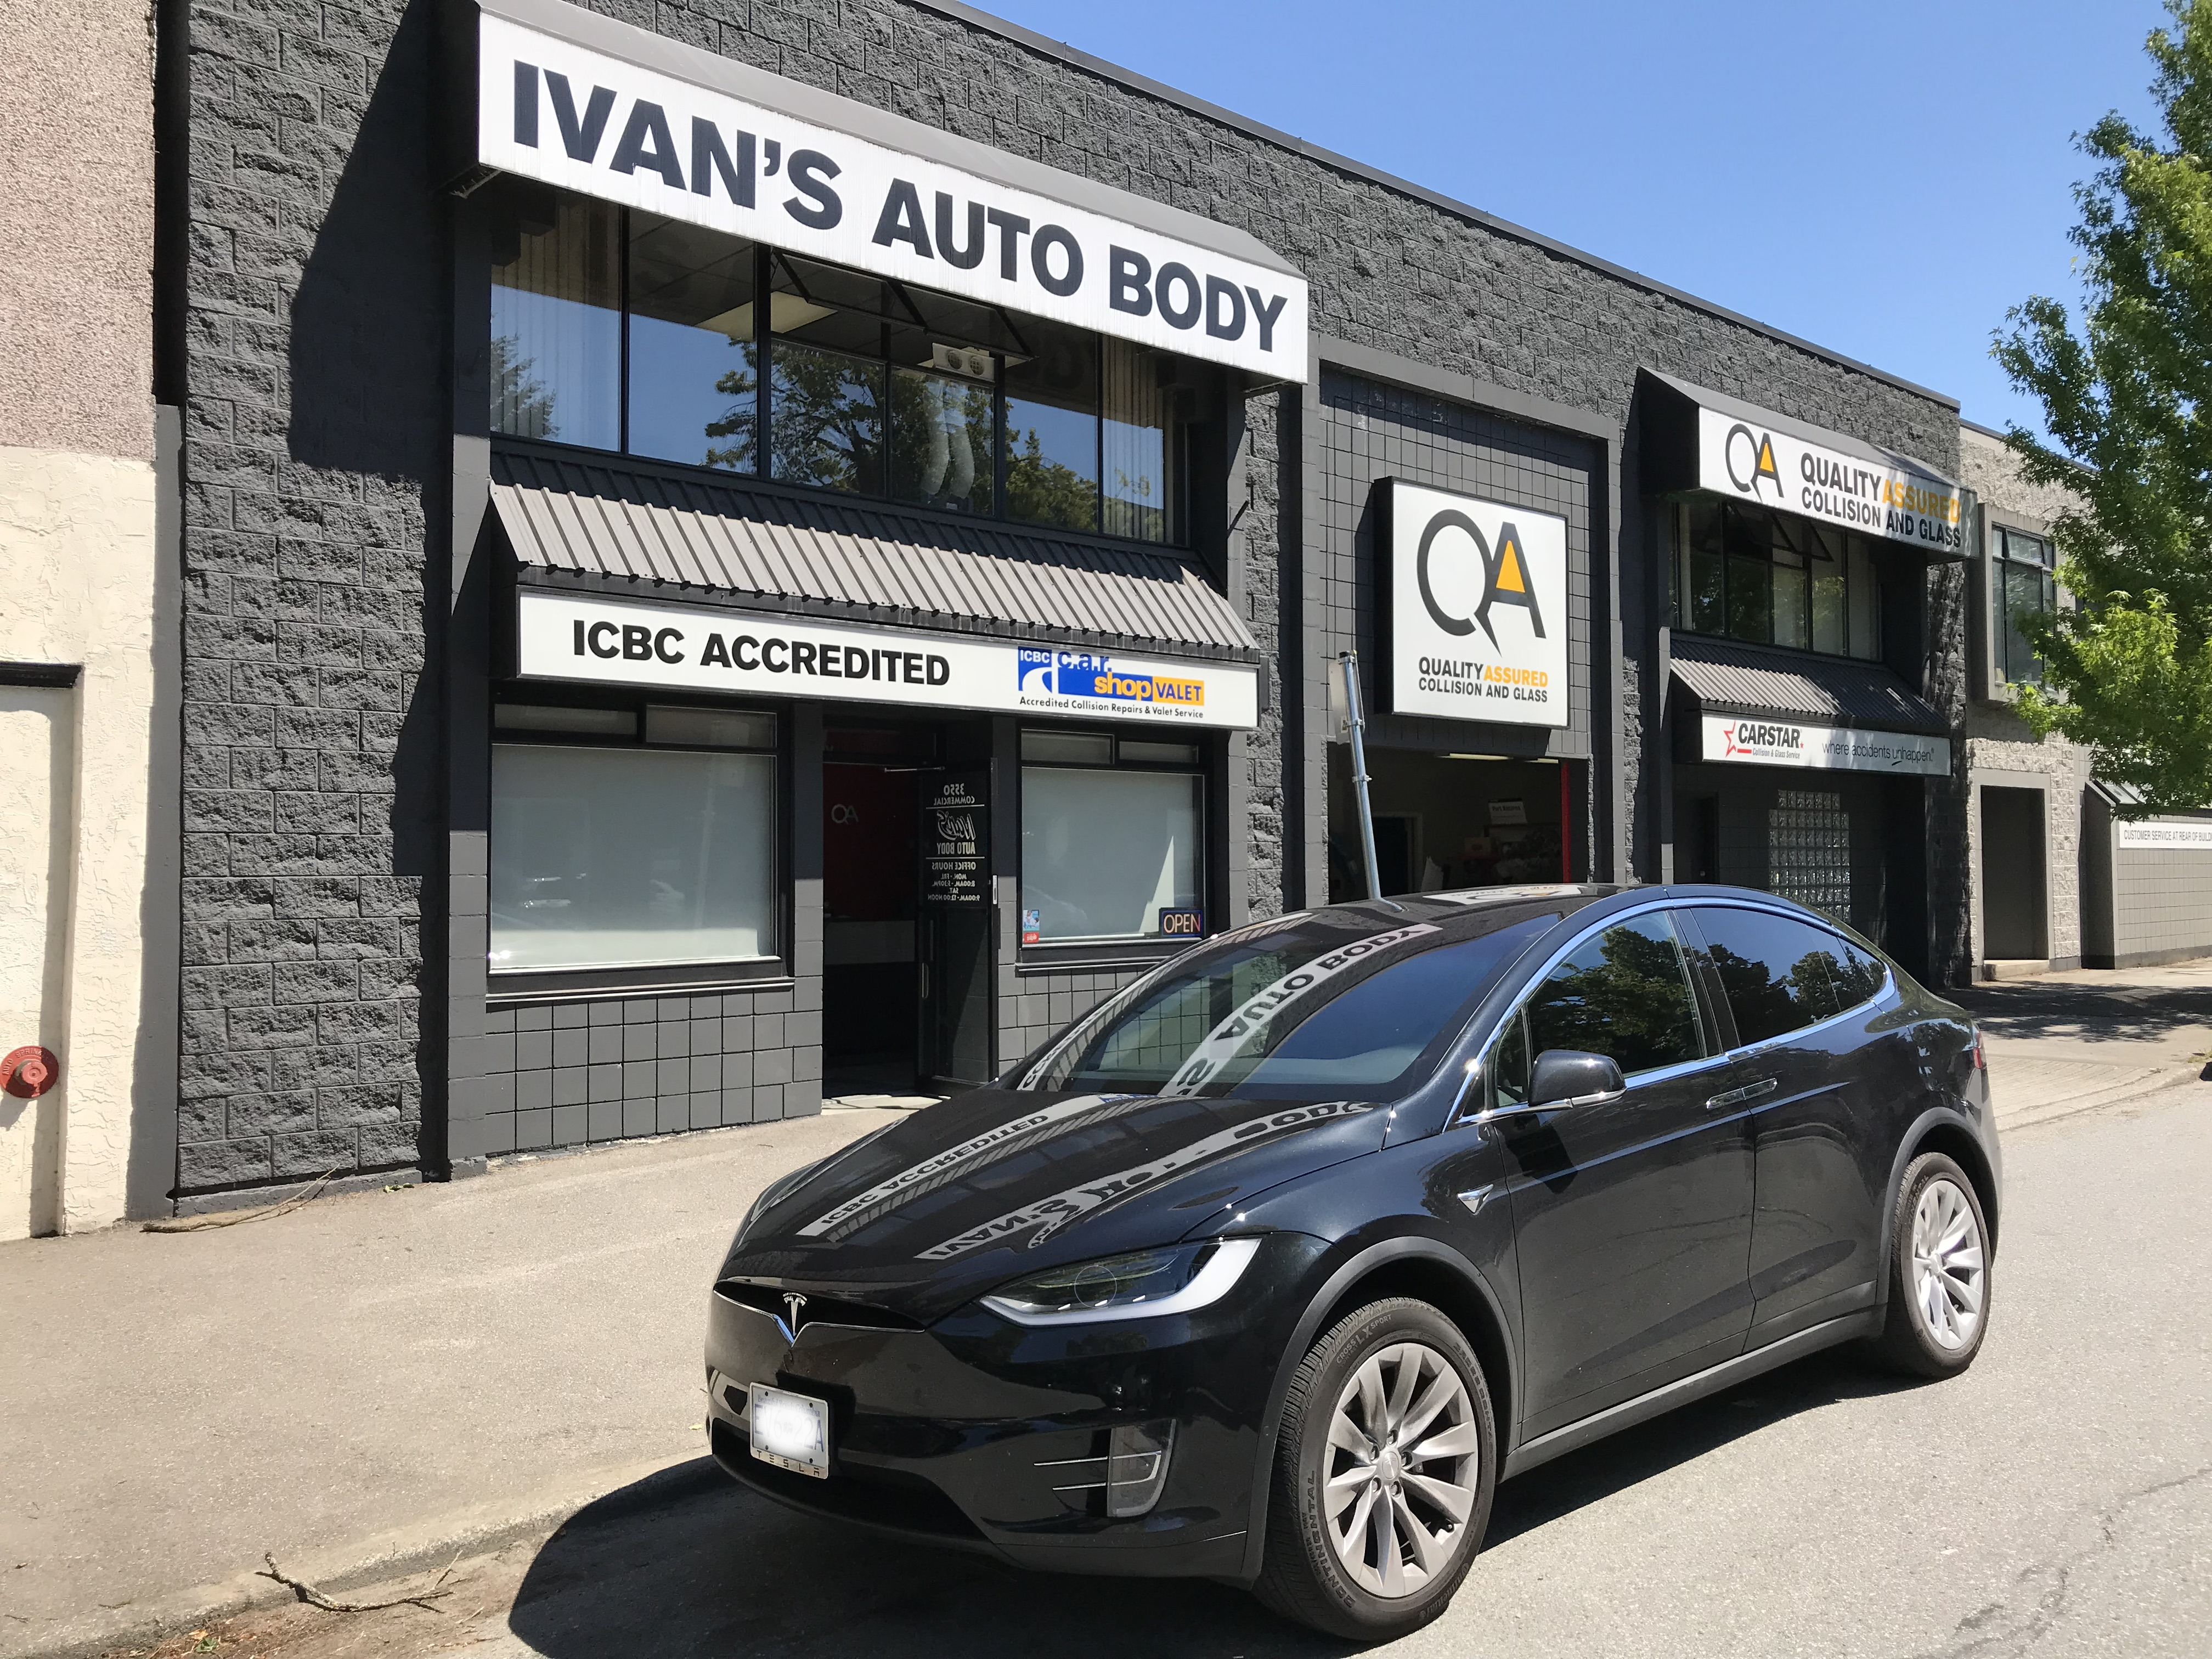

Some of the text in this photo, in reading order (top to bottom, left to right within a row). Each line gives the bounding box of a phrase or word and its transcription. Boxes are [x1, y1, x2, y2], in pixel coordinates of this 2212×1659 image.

[514, 60, 1288, 352] IVAN'S AUTO BODY
[1725, 424, 1784, 502] QA
[1801, 452, 1961, 523] QUALITY ASSURED
[1802, 486, 1961, 548] COLLISION AND GLASS
[1417, 509, 1546, 658] QA
[573, 619, 950, 686] ICBC ACCREDITED
[1020, 650, 1049, 663] ICBC
[1419, 657, 1548, 687] QUALITY ASSURED
[1094, 672, 1202, 702] shop VALET
[1419, 677, 1548, 703] COLLISION AND GLASS
[1020, 696, 1204, 718] Accredited Collision Repairs & Valet Service
[1739, 723, 1801, 748] CARSTAR
[1753, 748, 1770, 757] Collision
[1822, 740, 1849, 755] where
[1852, 744, 1891, 758] accidents
[831, 804, 859, 825] QA
[2124, 830, 2151, 840] CUSTOMER
[2152, 830, 2171, 840] SERVICE
[2172, 831, 2179, 840] AT
[2179, 831, 2191, 841] REAR
[2192, 832, 2198, 841] OF
[1164, 913, 1201, 934] OPEN
[2, 1058, 13, 1075] AUTO
[1336, 1339, 1357, 1364] CROSS
[1370, 1314, 1392, 1330] SPORT
